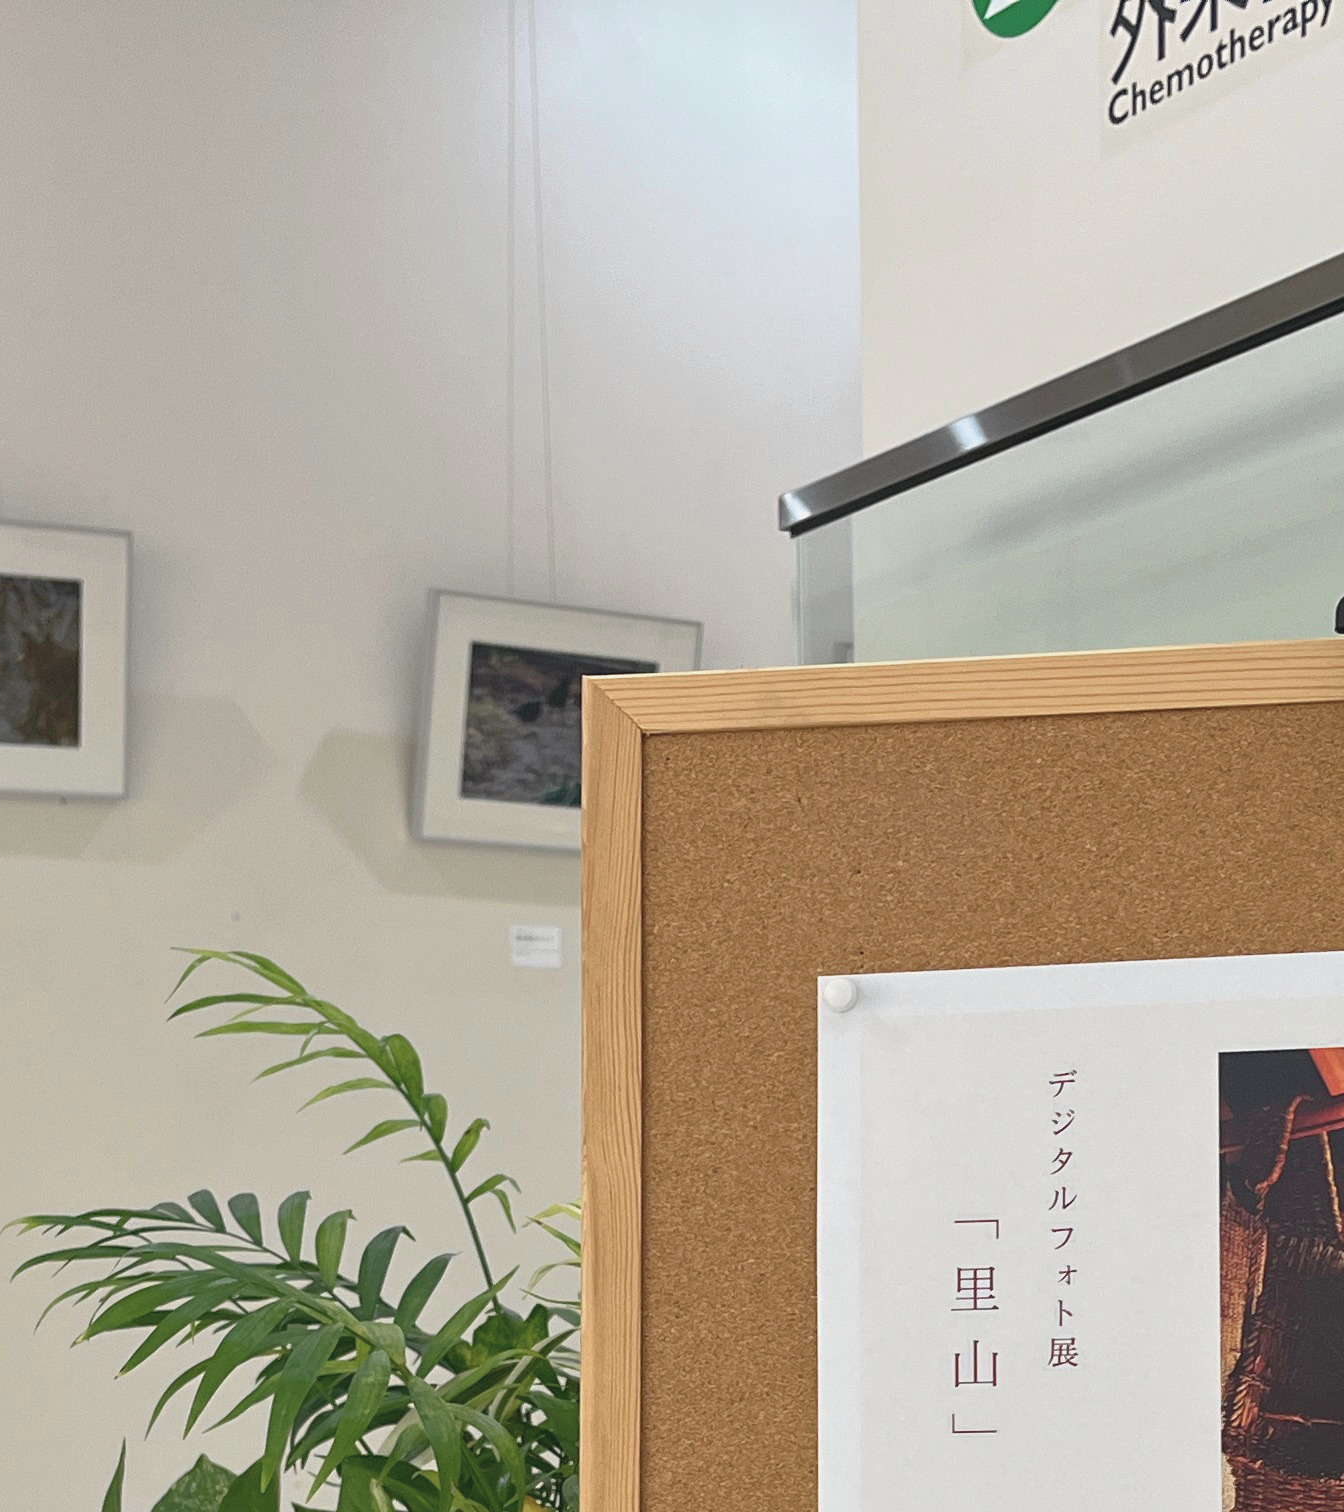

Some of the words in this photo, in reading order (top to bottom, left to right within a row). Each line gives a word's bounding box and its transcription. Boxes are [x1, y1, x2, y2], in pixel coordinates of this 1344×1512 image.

[1108, 0, 1332, 125] Chemotherapy
[1048, 1069, 1078, 1367] デジタルフォト展
[951, 1219, 999, 1434] 「里山」
